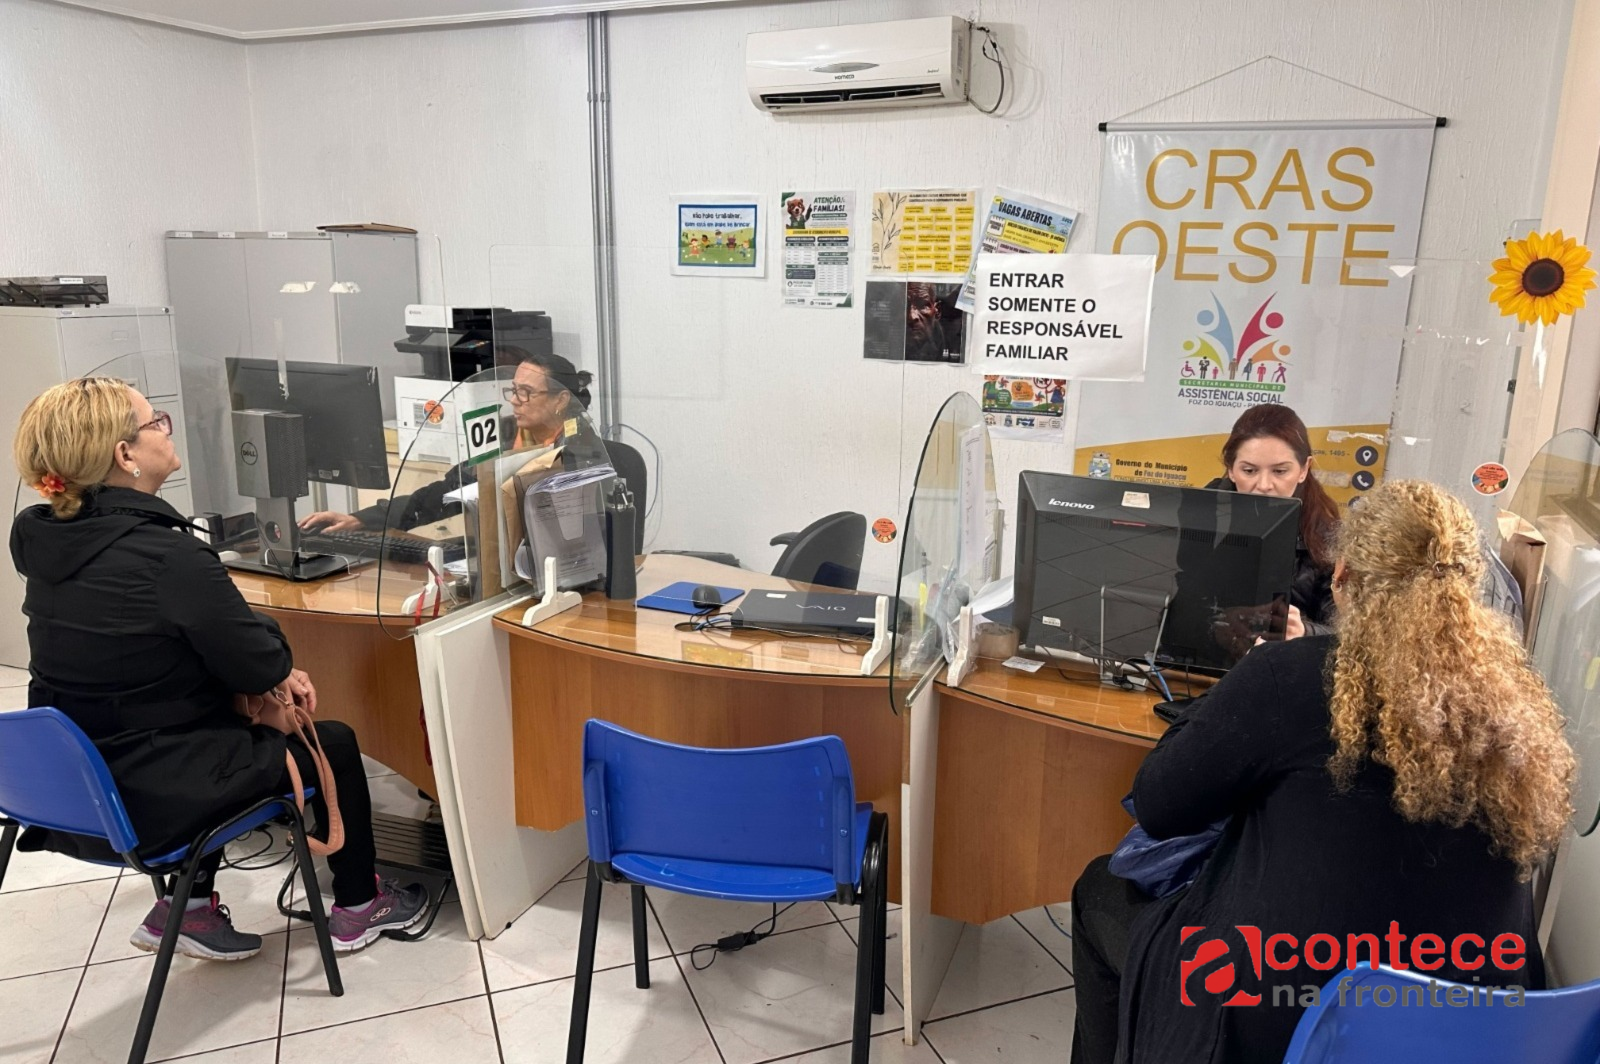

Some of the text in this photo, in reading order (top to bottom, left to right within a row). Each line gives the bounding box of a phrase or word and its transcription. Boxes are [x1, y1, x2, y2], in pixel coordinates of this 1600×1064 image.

[1145, 146, 1376, 212] CRAS
[998, 201, 1022, 218] VAGAS
[1020, 207, 1053, 227] ABERTAS
[1111, 219, 1396, 288] OESTE
[989, 272, 1064, 288] ENTRAR
[988, 297, 1096, 314] SOMENTE O
[987, 320, 1123, 339] RESPONSÁVEL
[986, 344, 1069, 361] FAMILIAR
[1229, 382, 1269, 390] MUNICIPAL
[1178, 388, 1284, 404] ASSISTÊNCIA SOCIAL
[1215, 400, 1242, 408] IGUAÇU
[470, 418, 497, 447] 02
[1115, 458, 1142, 468] Governo
[1144, 461, 1153, 469] do
[1144, 469, 1154, 477] Foz
[1154, 470, 1163, 478] do
[1048, 498, 1095, 510] lenovo
[796, 603, 846, 611] VAIO
